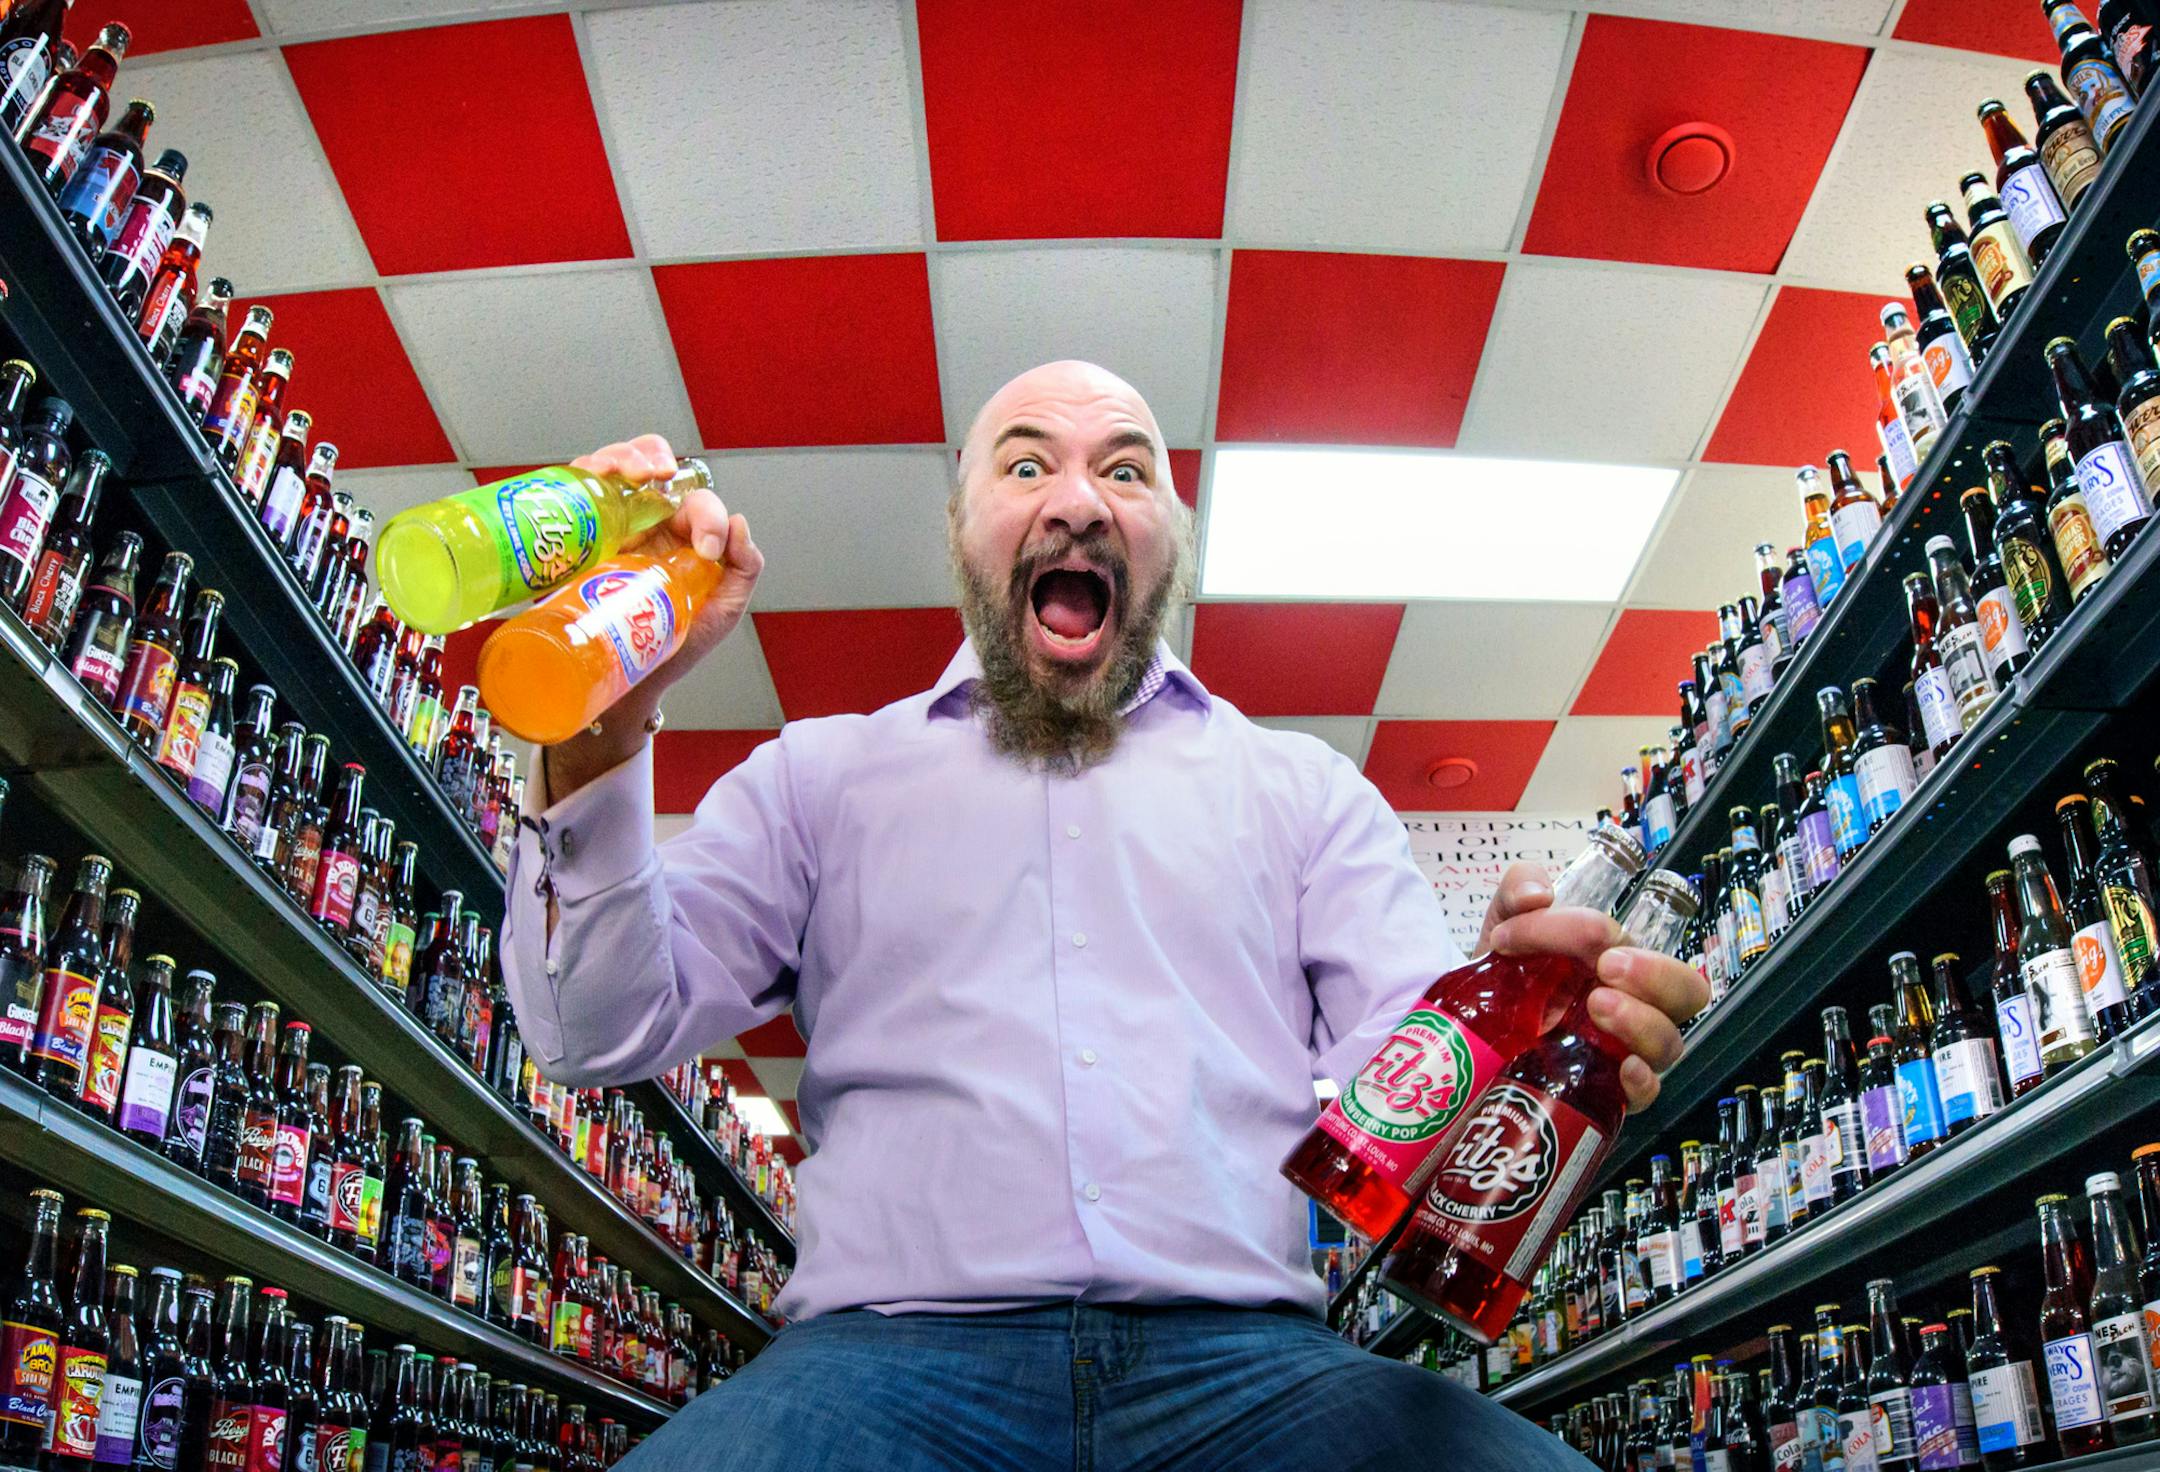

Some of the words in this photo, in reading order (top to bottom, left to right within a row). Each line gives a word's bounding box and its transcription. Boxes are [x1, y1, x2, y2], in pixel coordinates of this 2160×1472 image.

[40, 558, 60, 588] Cherry
[1404, 820, 1583, 832] REEDOM
[1457, 836, 1511, 847] OF
[1438, 864, 1501, 875] And
[51, 1036, 77, 1056] Black
[1405, 1026, 1453, 1064] PREMIUM
[1358, 1034, 1457, 1118] Fitz's
[1480, 1103, 1532, 1135] PREMIUM
[1391, 1127, 1419, 1139] POP
[1448, 1115, 1542, 1193] Fitz's
[1385, 1158, 1399, 1172] MO
[1445, 1200, 1498, 1220] CHERRY
[1457, 1228, 1481, 1249] LOUIS,
[1480, 1240, 1496, 1255] MO
[2064, 1345, 2083, 1380] S
[8, 1397, 35, 1415] Black
[209, 1450, 237, 1466] BLACK
[1776, 1443, 1801, 1461] Cola
